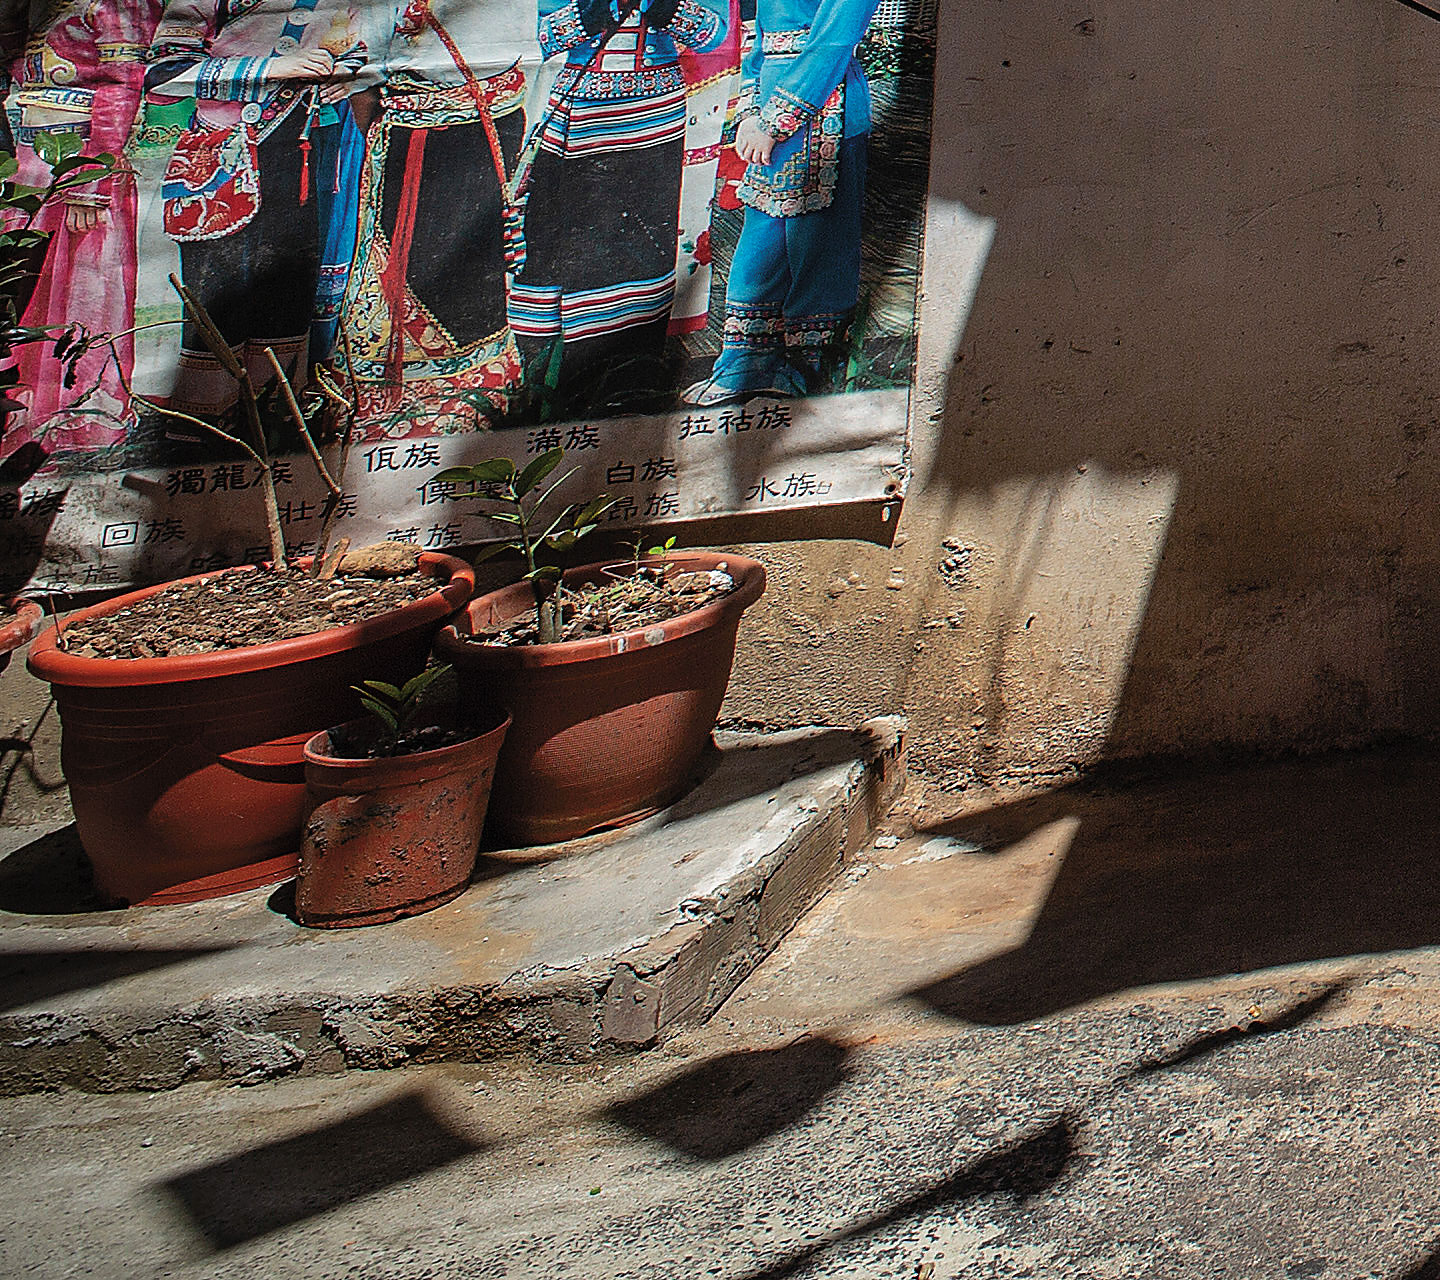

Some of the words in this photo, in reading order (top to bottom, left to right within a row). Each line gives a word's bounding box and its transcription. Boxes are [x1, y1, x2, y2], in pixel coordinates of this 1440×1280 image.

[679, 405, 793, 439] 拉祜族
[527, 426, 601, 454] 滿族
[364, 442, 441, 473] 佤族
[606, 456, 677, 485] 白族
[166, 460, 293, 496] 獨龍族
[745, 472, 817, 501] 水族
[102, 518, 185, 548] 回族
